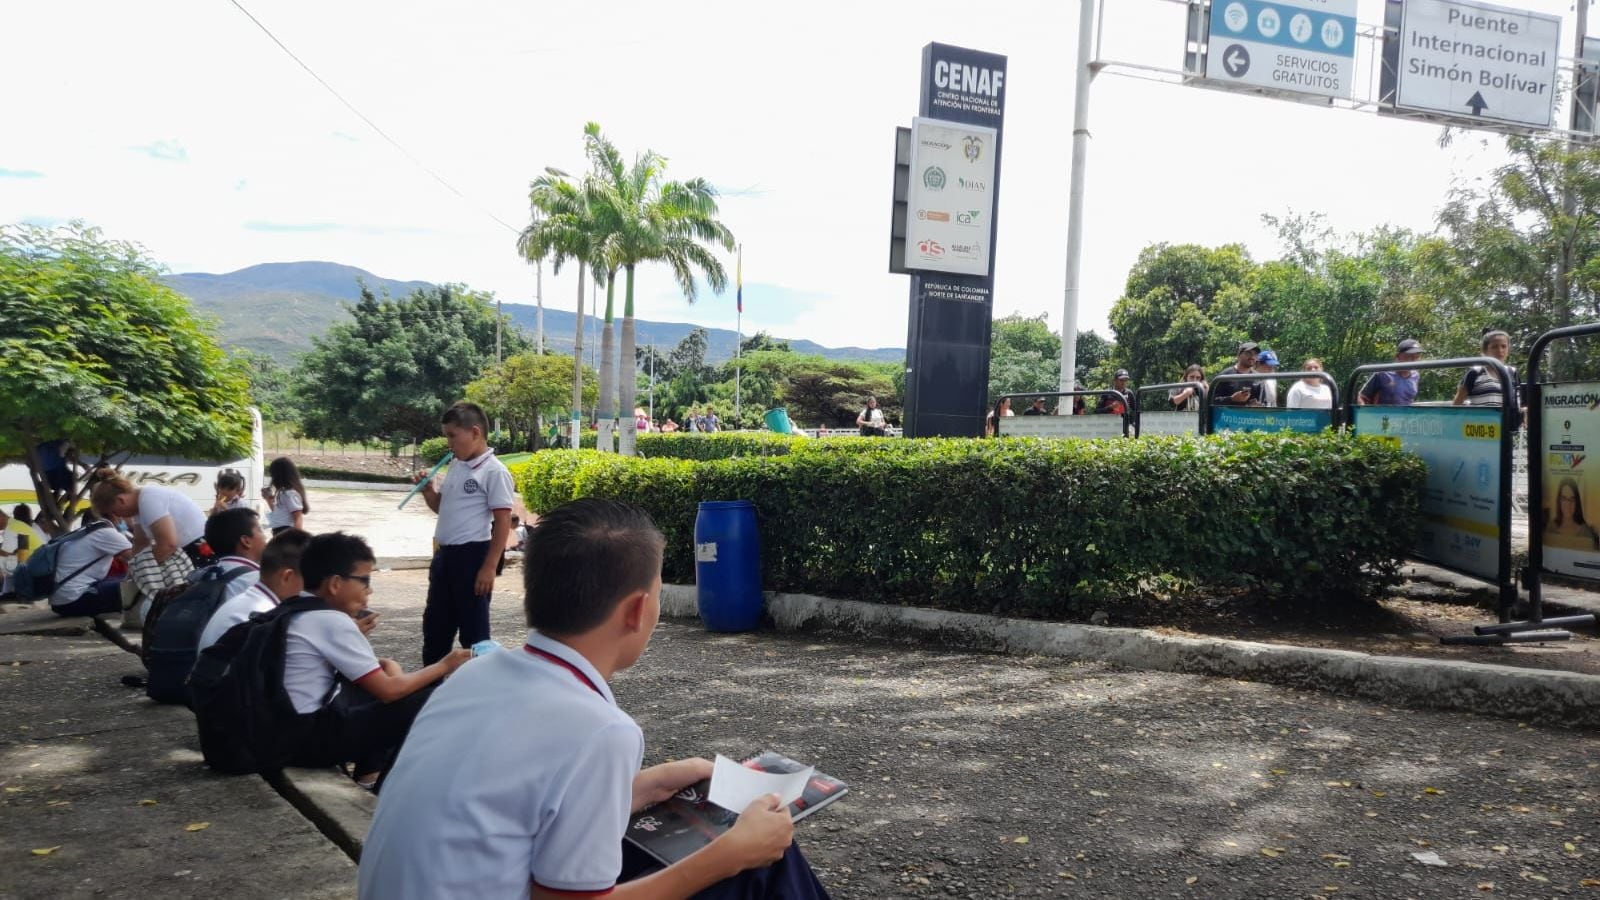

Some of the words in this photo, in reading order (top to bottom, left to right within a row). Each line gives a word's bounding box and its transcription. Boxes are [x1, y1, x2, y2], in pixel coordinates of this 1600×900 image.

[1448, 8, 1519, 35] Puente
[1411, 30, 1546, 67] Internacional
[1276, 54, 1338, 75] SERVICIOS
[934, 59, 1004, 97] CENAF
[1272, 69, 1340, 90] GRATUITOS
[1408, 57, 1473, 84] Simón
[1479, 69, 1547, 95] Bolívar
[937, 91, 960, 101] CENTRO
[960, 95, 990, 106] NACIONAL
[962, 103, 971, 111] EN
[971, 104, 1001, 116] FRONTERAS
[965, 181, 986, 192] DIAN
[928, 290, 946, 298] NORTE
[954, 293, 985, 302] SANTANDER
[953, 284, 960, 292] DE
[960, 286, 989, 295] COLOMBIA
[1464, 423, 1496, 439] COVID-19
